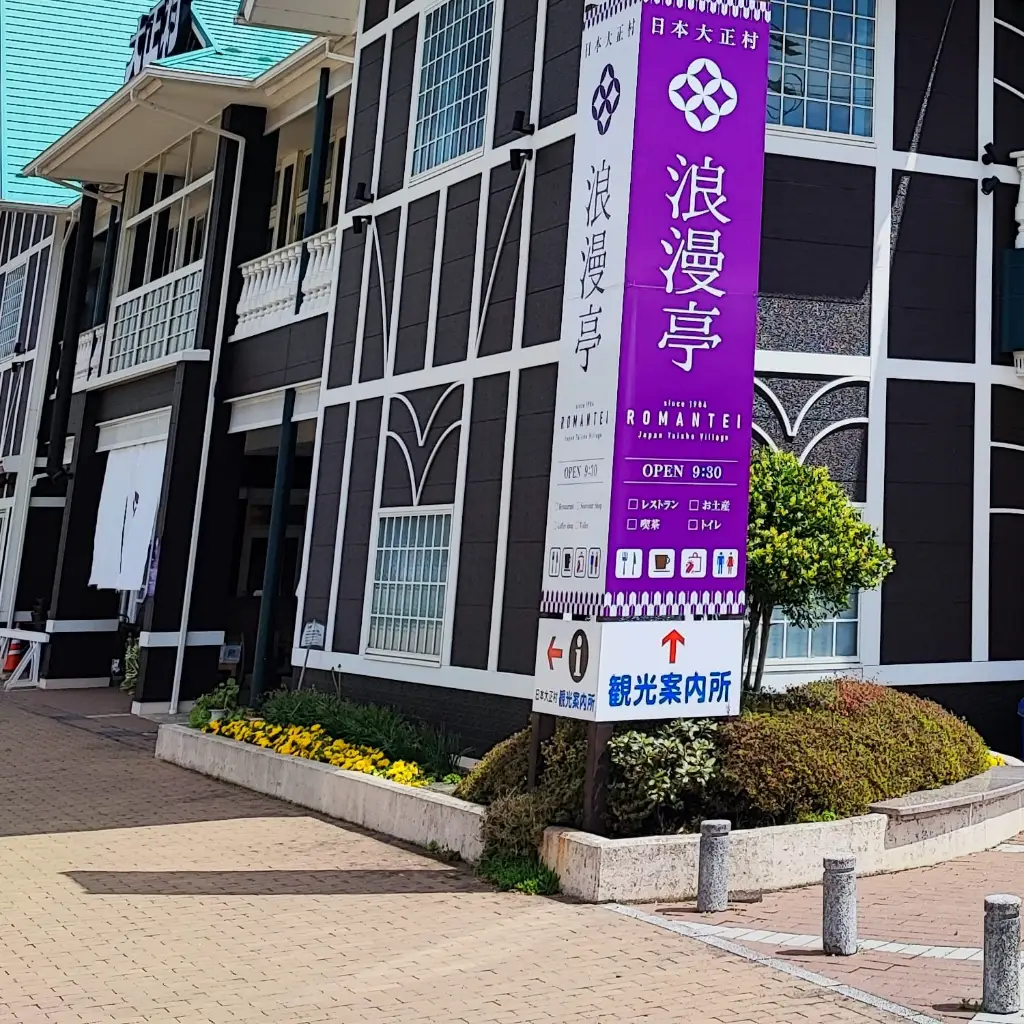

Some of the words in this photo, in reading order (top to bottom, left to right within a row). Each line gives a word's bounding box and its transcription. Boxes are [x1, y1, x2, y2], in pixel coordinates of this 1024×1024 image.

[584, 18, 636, 58] 日本大正村
[651, 16, 759, 50] 日本大正村
[574, 159, 611, 372] 浪漫亭
[658, 154, 731, 372] 浪漫亭
[560, 410, 609, 430] ROMANTEI
[627, 409, 741, 429] ROMANTEI
[637, 431, 663, 440] Japan
[563, 465, 582, 480] OPEN
[642, 464, 684, 478] OPEN
[692, 465, 722, 479] 9:30
[641, 499, 679, 511] レストラン
[701, 500, 731, 512] お土産
[640, 519, 660, 530] 喫茶
[701, 520, 722, 530] トイレ
[608, 670, 732, 707] 観光案内所
[558, 689, 595, 712] 観光案内所
